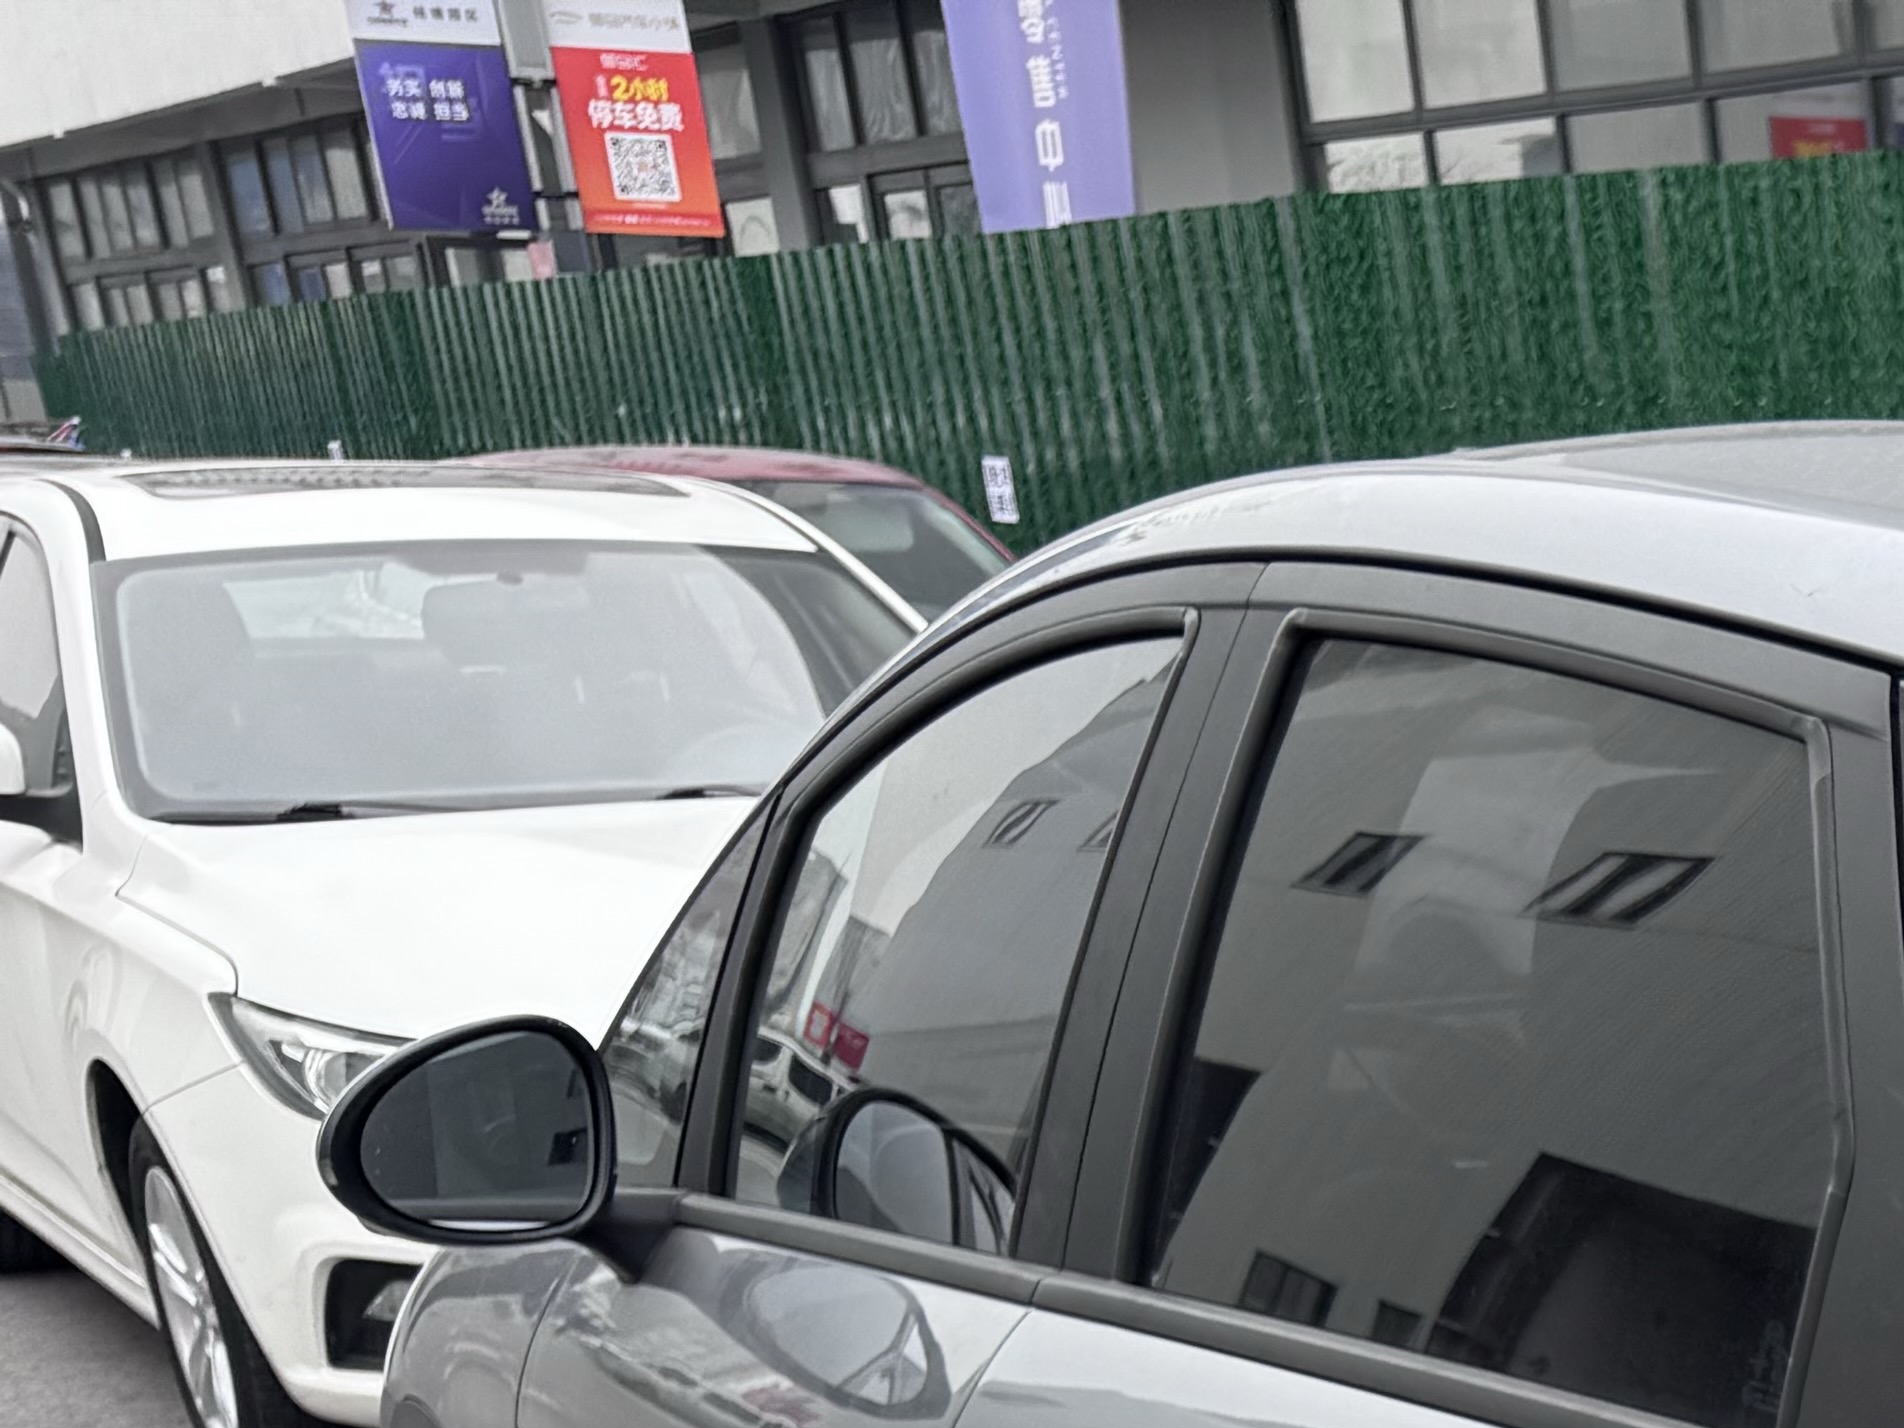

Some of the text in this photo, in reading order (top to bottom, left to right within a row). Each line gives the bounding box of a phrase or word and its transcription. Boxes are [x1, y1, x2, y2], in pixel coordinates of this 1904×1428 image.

[610, 75, 670, 102] 2小时
[588, 99, 685, 132] 停车免费
